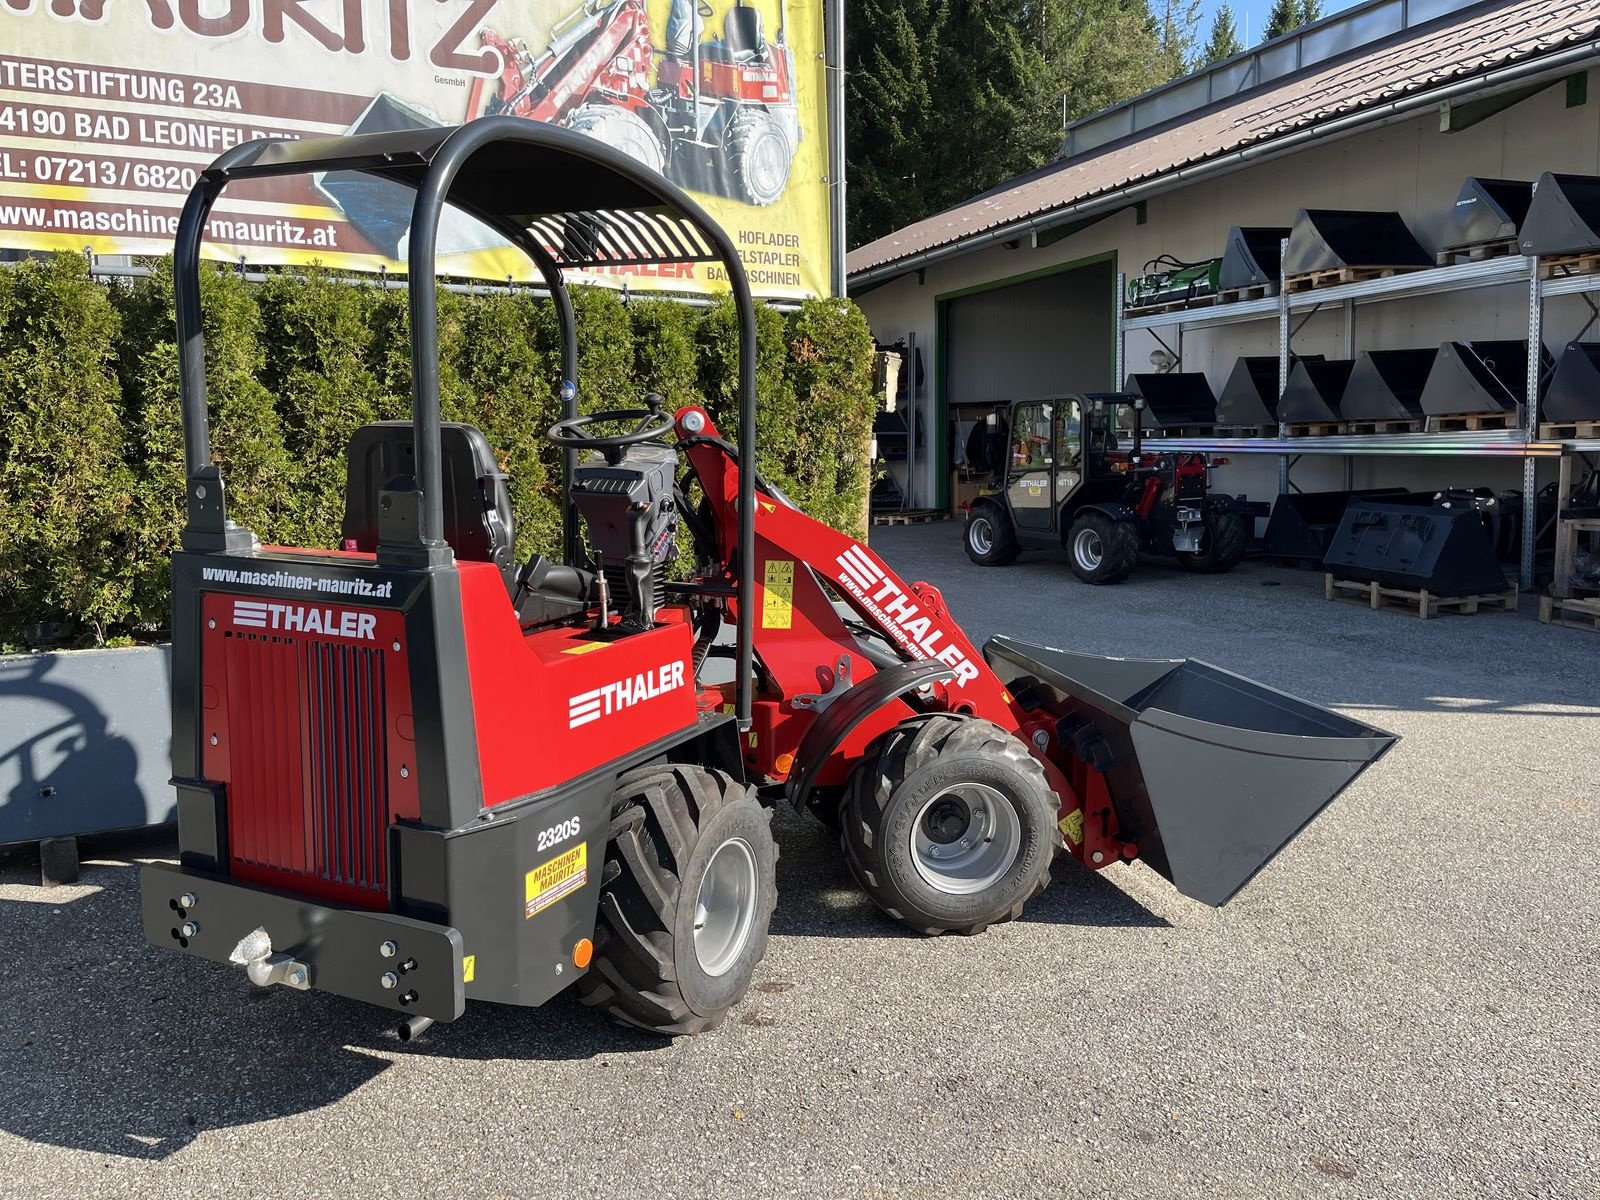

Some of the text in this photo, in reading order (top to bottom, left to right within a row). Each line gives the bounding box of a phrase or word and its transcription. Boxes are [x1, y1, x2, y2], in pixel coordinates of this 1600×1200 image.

[0, 60, 242, 109] TERSTIFTUNG 23A
[434, 75, 466, 87] GesmbH
[0, 106, 300, 150] 4190 BAD LEONFEL
[0, 205, 337, 247] ww.maschine-mauritz.at
[739, 230, 800, 247] HOFLADER
[707, 267, 800, 286] BAUASCHINEN
[737, 250, 800, 267] ELSTAPLER
[203, 568, 392, 598] www.maschinen-mauritz.at
[268, 604, 377, 640] THALER
[872, 576, 979, 689] THALER
[601, 660, 685, 716] THALER
[537, 815, 581, 852] 2320S
[533, 847, 581, 884] MASCHINEN
[539, 861, 576, 893] MAURITZ
